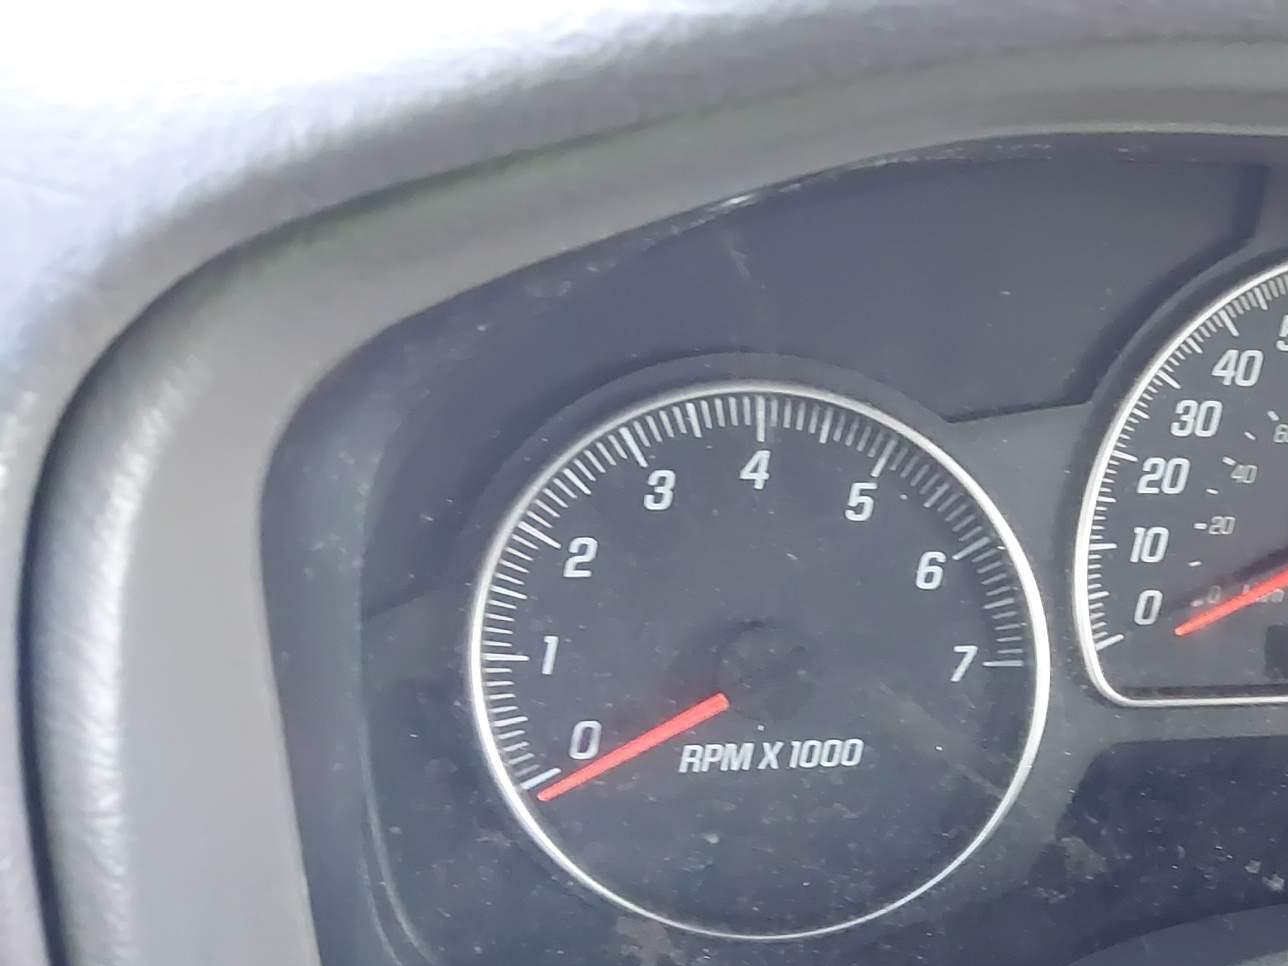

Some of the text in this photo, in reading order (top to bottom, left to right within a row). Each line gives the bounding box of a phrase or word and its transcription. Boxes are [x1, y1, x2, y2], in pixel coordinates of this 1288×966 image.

[1212, 349, 1264, 386] 40
[1171, 400, 1222, 437] 30
[740, 450, 771, 489] 4
[1137, 458, 1190, 494] 20
[1230, 465, 1258, 484] 40
[644, 469, 676, 510] 3
[844, 482, 878, 521] 5
[1208, 516, 1235, 535] 20
[563, 537, 597, 578] 2
[1130, 526, 1169, 563] 10
[916, 550, 946, 590] 6
[1134, 590, 1162, 626] 0
[542, 636, 559, 675] 1
[950, 645, 978, 682] 7
[570, 721, 601, 760] 0
[679, 739, 864, 774] RPM X 1000
